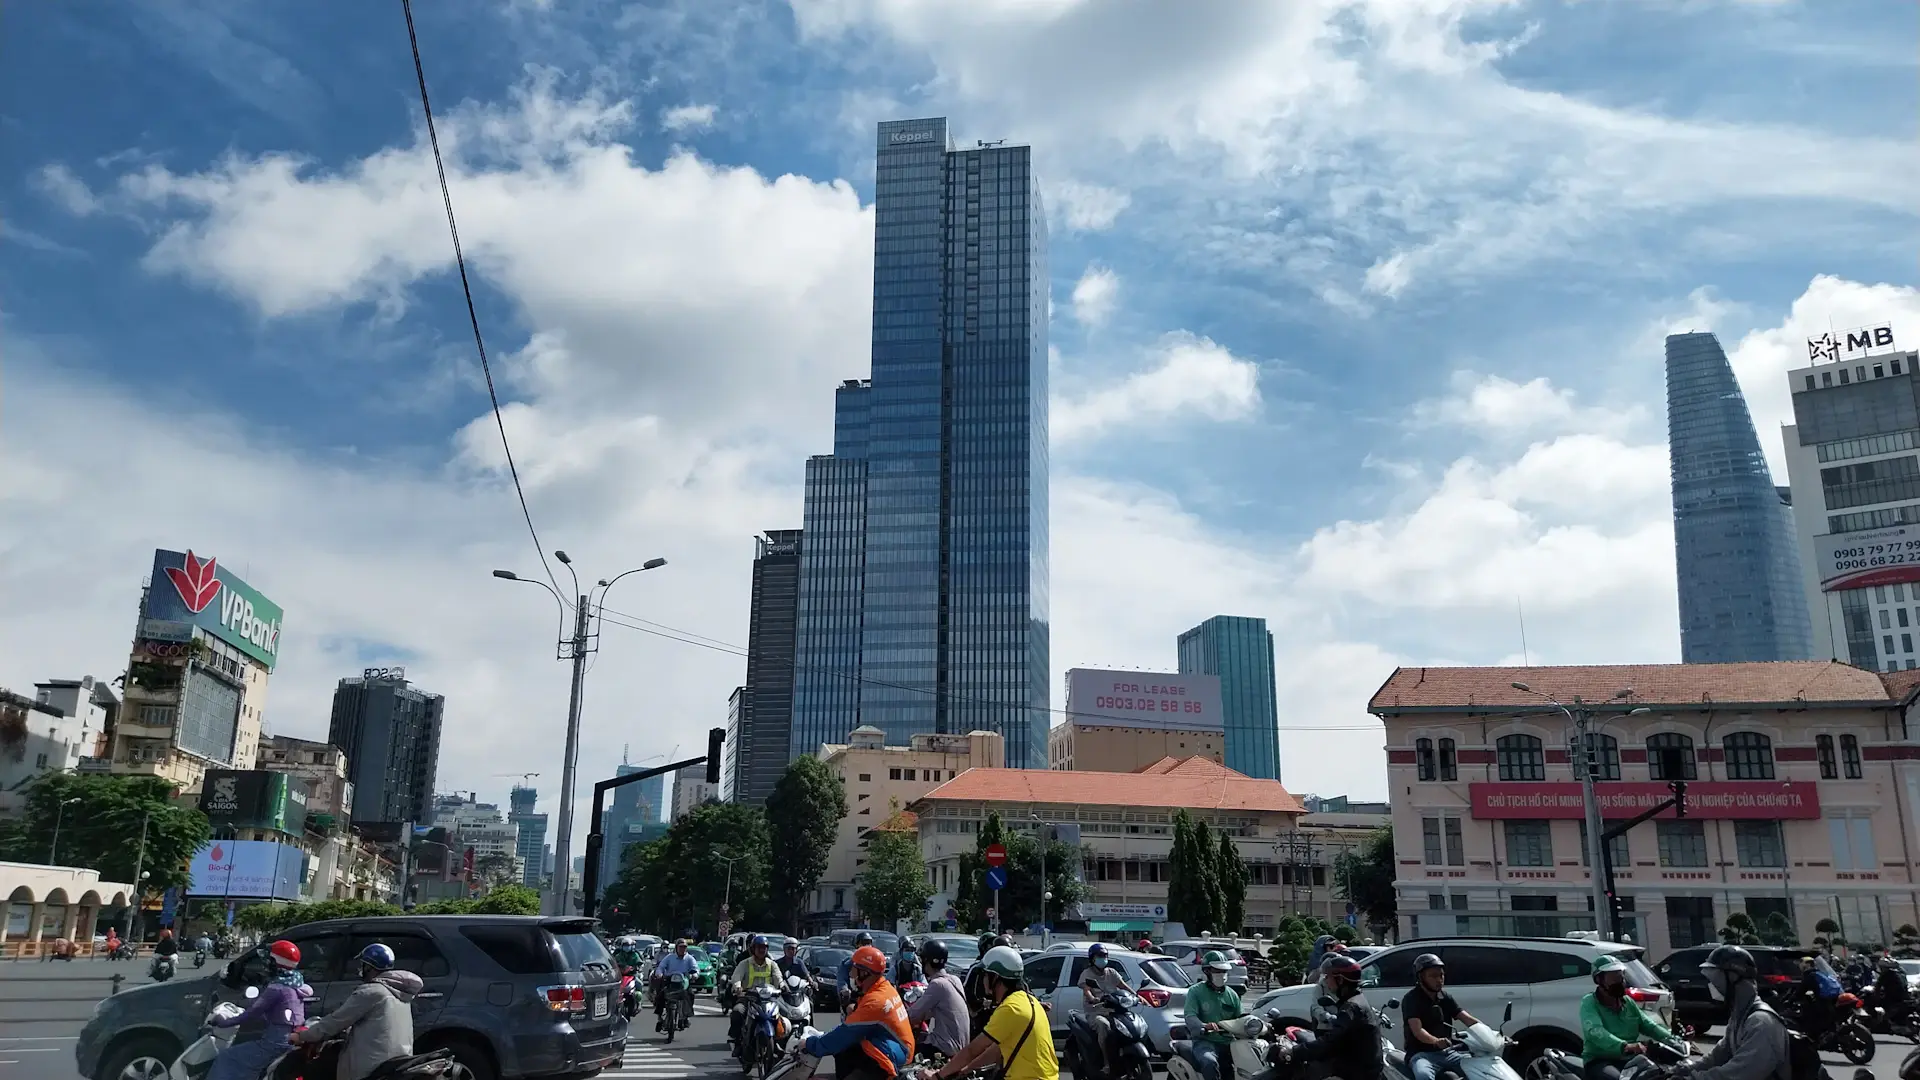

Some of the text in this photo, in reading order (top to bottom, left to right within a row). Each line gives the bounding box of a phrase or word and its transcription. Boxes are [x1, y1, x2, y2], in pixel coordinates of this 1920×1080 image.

[891, 130, 933, 143] Keppel
[1847, 327, 1893, 352] MB
[767, 544, 794, 552] Keppel
[1834, 547, 1865, 559] 0903
[1868, 545, 1884, 555] 79
[1886, 542, 1902, 553] 77
[1836, 558, 1867, 570] 0906
[1870, 556, 1886, 566] 68
[1889, 554, 1905, 564] 22
[219, 583, 280, 656] VPBank
[1113, 682, 1186, 696] FOR LEASE
[1096, 696, 1155, 711] 0903.02
[207, 802, 238, 810] SAIGON
[1487, 792, 1506, 807] CHỦ
[1507, 795, 1527, 808] TỊCH
[1542, 792, 1558, 807] CHÍ
[1559, 795, 1582, 807] MINH
[1702, 792, 1734, 809] NGHIỆP
[1737, 791, 1757, 807] CỦA
[1757, 791, 1788, 807] CHÚNG
[1790, 794, 1803, 807] TA
